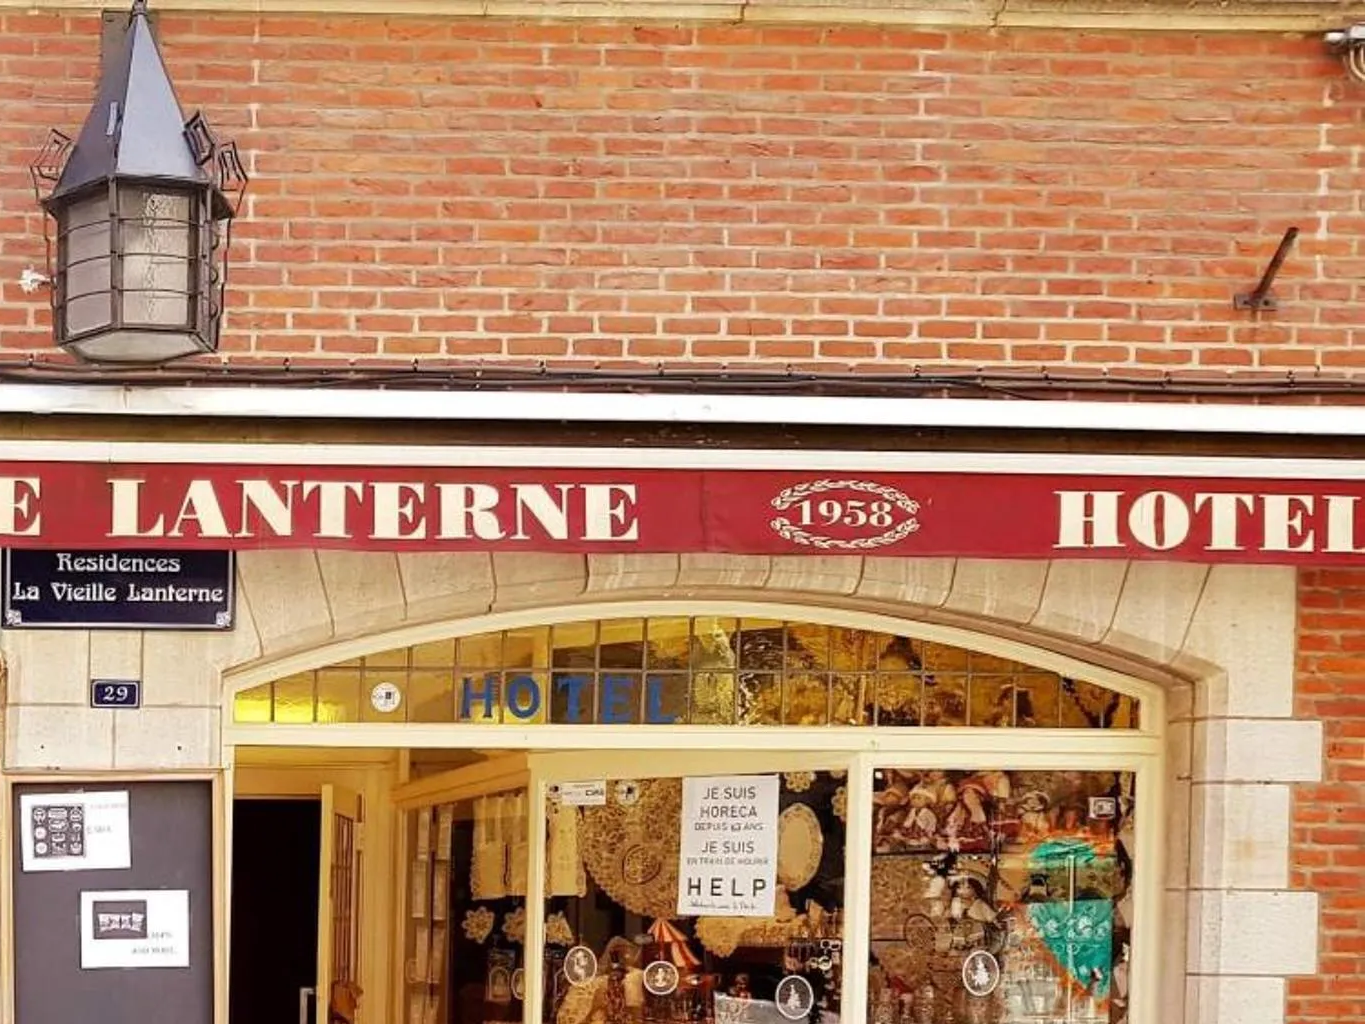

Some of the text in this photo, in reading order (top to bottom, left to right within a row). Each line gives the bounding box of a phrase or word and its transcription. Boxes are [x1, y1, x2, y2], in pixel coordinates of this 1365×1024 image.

[105, 479, 638, 541] LANTERNE
[798, 499, 894, 528] 1958
[1052, 490, 1365, 553] HOTEL
[56, 553, 182, 573] Residences
[12, 582, 225, 603] La Vieille Lanterne
[103, 686, 129, 701] 29
[460, 677, 678, 723] HOTEL
[703, 786, 756, 800] JE SUIS
[700, 806, 758, 818] HORECA
[702, 840, 755, 854] JE SUIS
[687, 877, 767, 897] HELP
